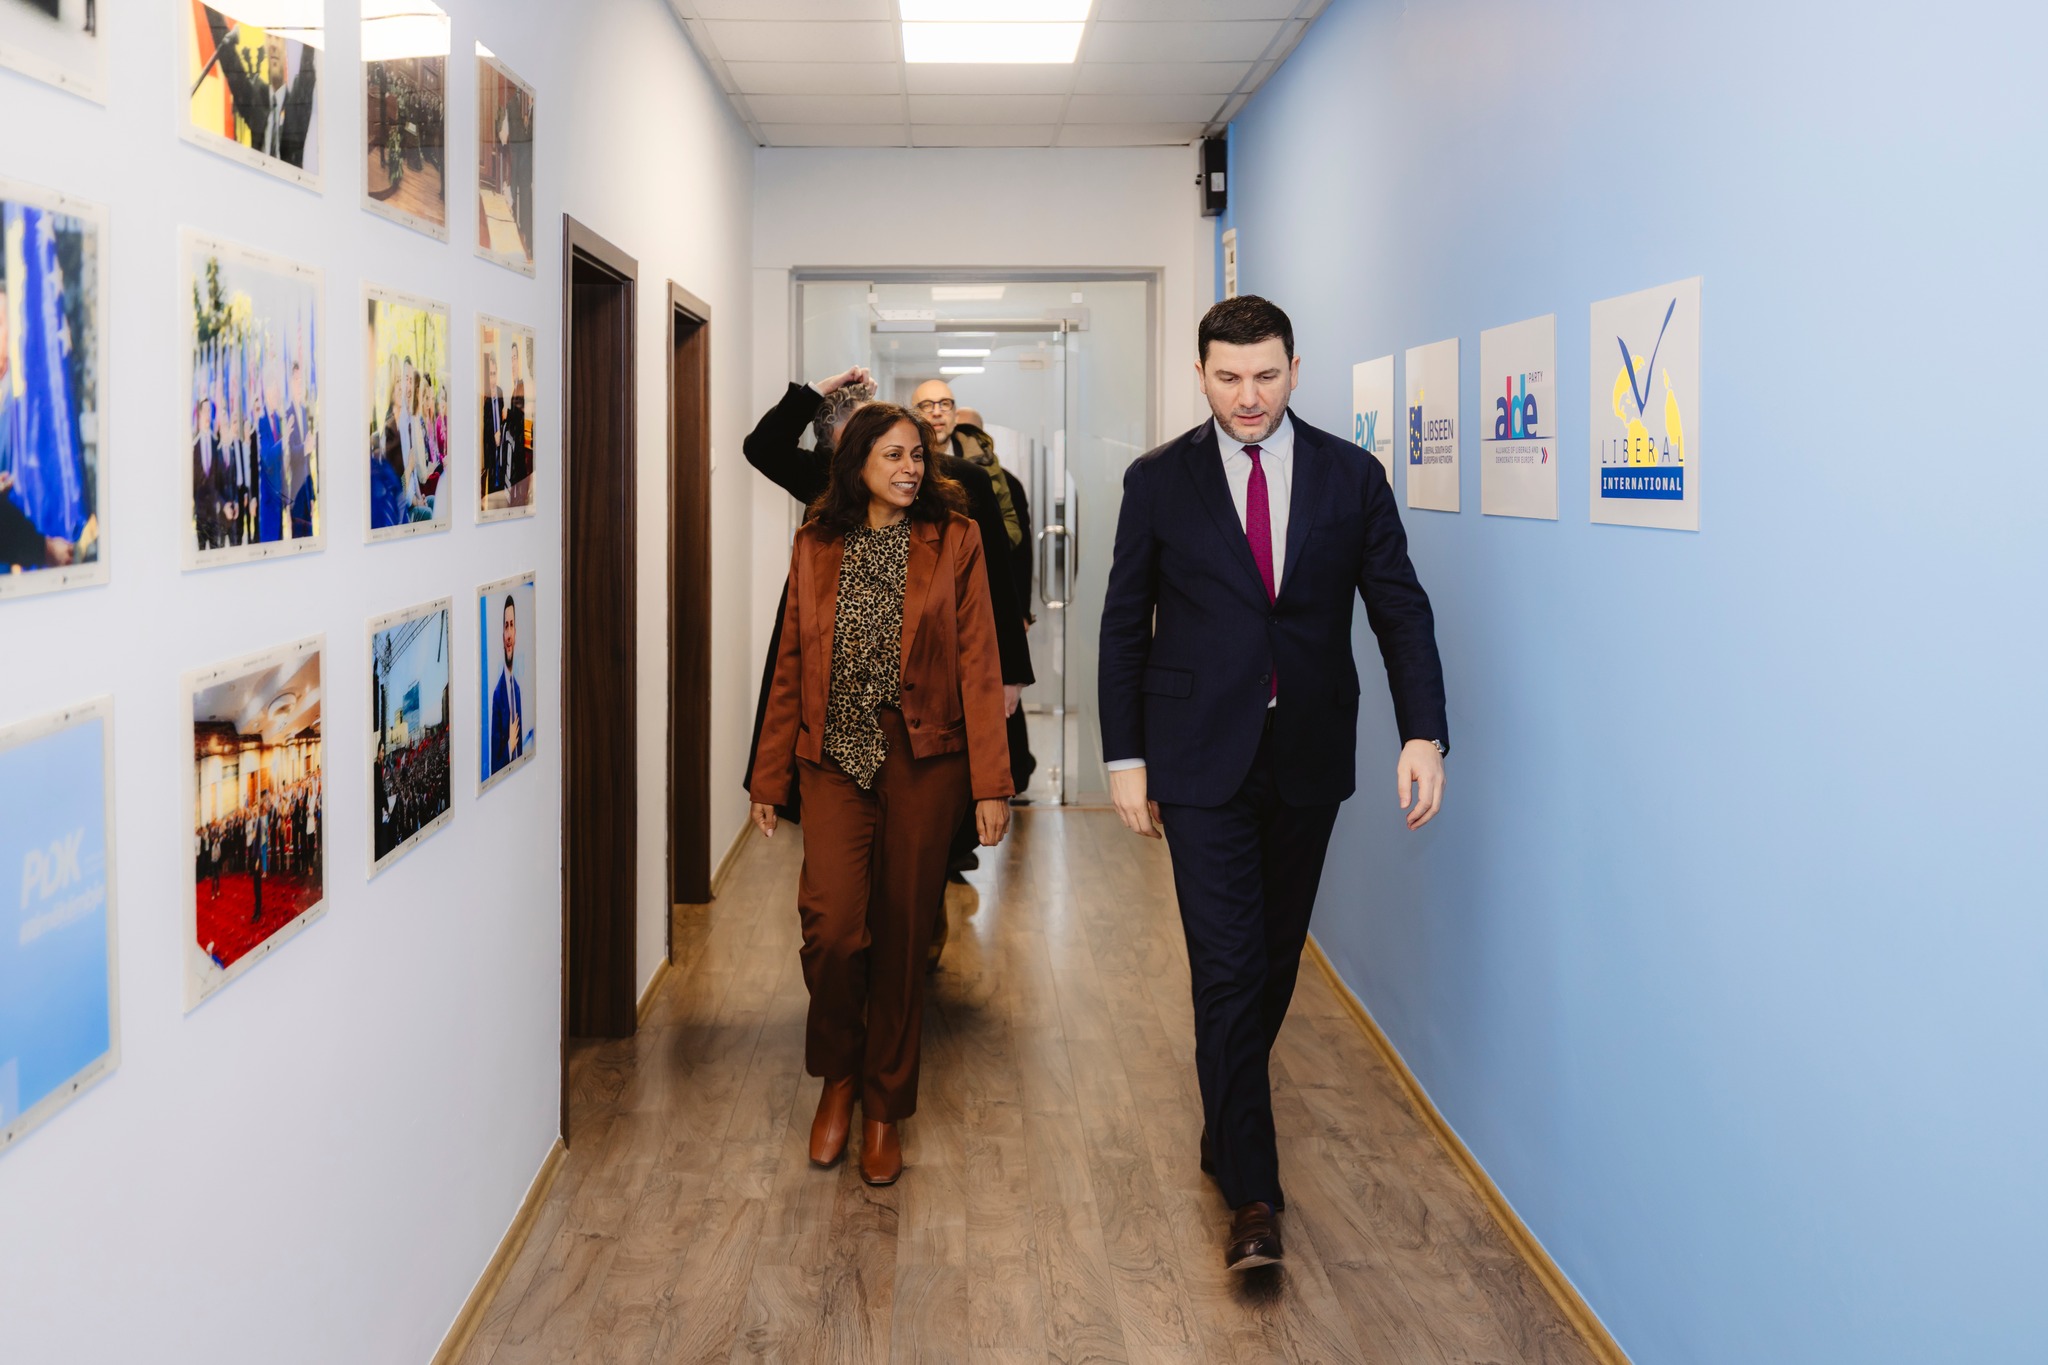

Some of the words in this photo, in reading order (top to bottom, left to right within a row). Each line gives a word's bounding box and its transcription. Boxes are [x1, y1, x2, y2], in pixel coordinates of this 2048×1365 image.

[1528, 371, 1543, 383] PARTY
[1495, 374, 1538, 440] alde
[1355, 410, 1378, 452] PDK
[1423, 418, 1454, 441] LIBSEEN
[1602, 436, 1684, 464] LIBERAL
[1603, 477, 1682, 491] INTERNATIONAL
[20, 826, 85, 909] PDK
